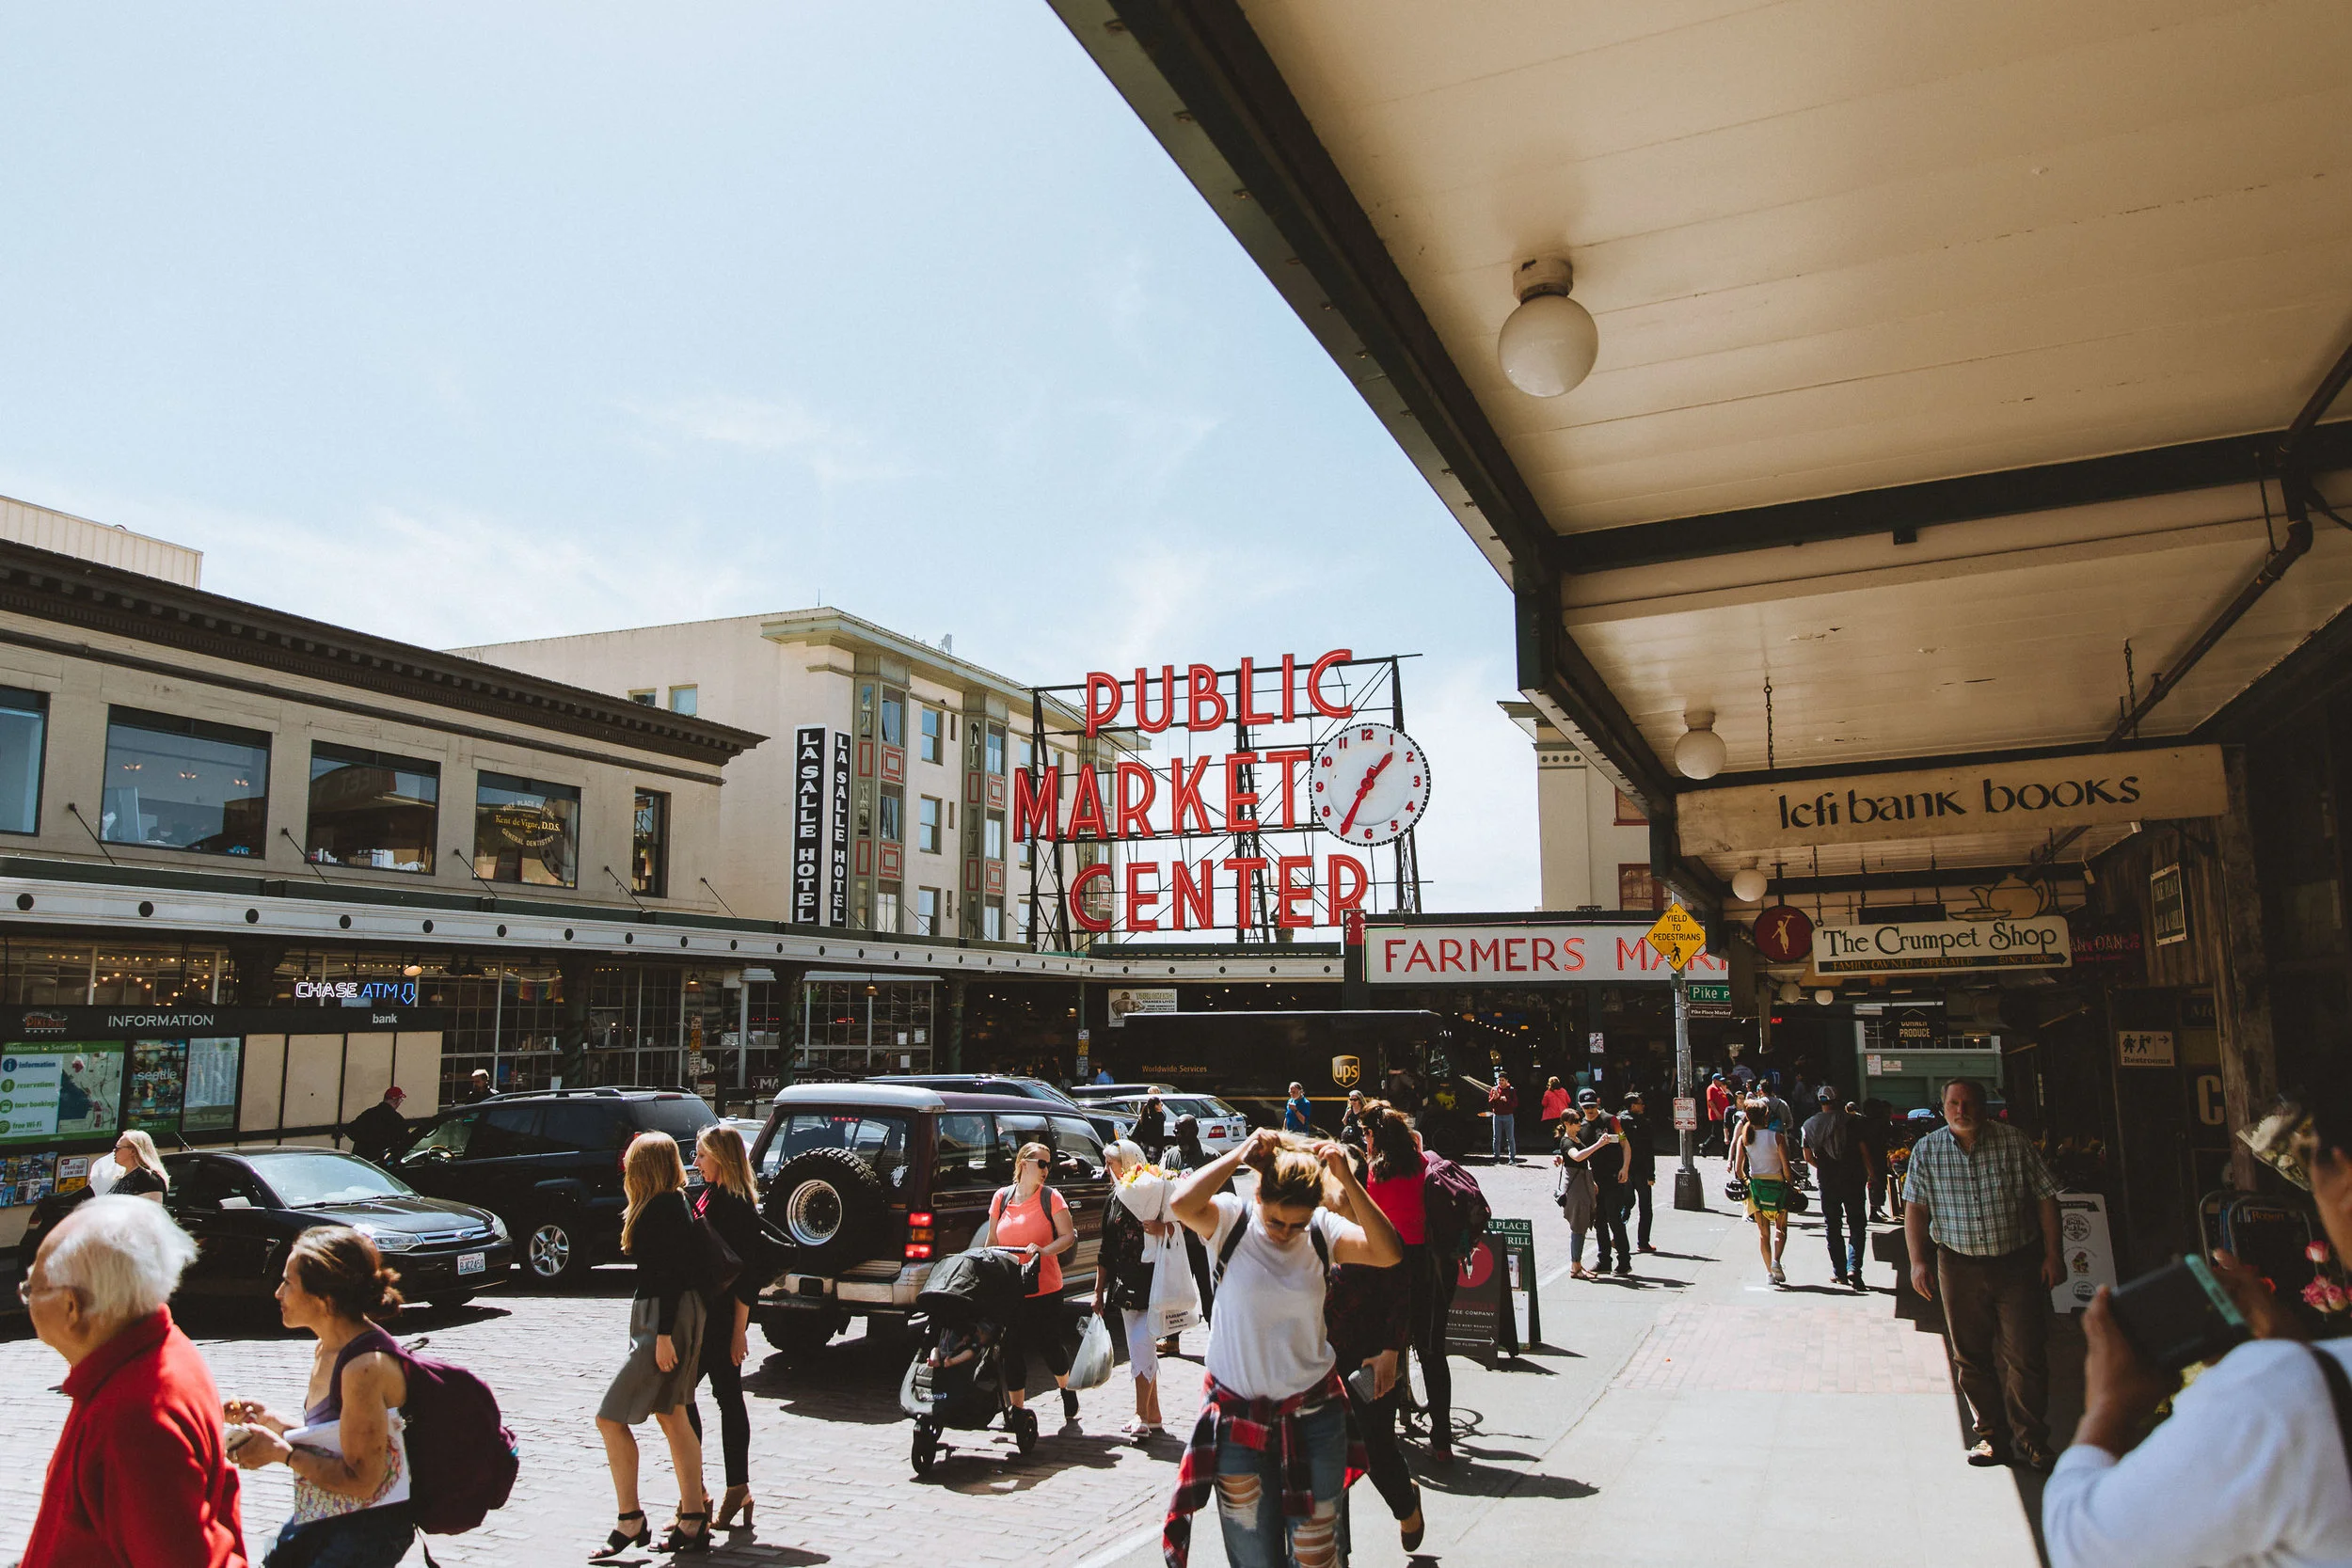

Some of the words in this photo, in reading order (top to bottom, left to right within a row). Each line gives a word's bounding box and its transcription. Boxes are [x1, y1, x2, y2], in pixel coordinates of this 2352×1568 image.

[1085, 648, 1354, 739] PUBLIC
[1360, 728, 1375, 742] 12
[1389, 734, 1394, 746] 1
[1338, 736, 1348, 750] 11
[836, 735, 848, 765] LA
[1321, 756, 1333, 768] 10
[1406, 751, 1415, 763] 2
[1315, 781, 1325, 793] 9
[1412, 775, 1422, 788] 3
[799, 766, 819, 838] SALLE
[1012, 750, 1311, 844] MARKET
[1847, 788, 1968, 825] bank
[1982, 775, 2142, 814] books
[834, 771, 848, 843] SALLE
[1322, 805, 1331, 817] 8
[1405, 800, 1416, 813] 4
[1390, 819, 1399, 832] 5
[501, 828, 524, 846] GENERAL
[526, 834, 555, 847] DENTISTRY
[1363, 828, 1374, 840] 6
[797, 848, 816, 923] HOTEL
[833, 849, 847, 923] HOTEL
[1069, 854, 1369, 932] CENTER
[1666, 914, 1688, 923] YIELD
[1823, 929, 1869, 958] The
[1874, 926, 1982, 958] Crumpet
[1988, 918, 2058, 956] Shop
[1384, 938, 1585, 973] FARMERS
[1997, 955, 2027, 965] SINCE
[295, 981, 358, 998] CHASE
[360, 983, 399, 999] ATM
[1692, 987, 1718, 999] Pike
[108, 1014, 215, 1027] INFORMATION
[372, 1013, 398, 1024] bank
[1899, 1028, 1931, 1037] PRODUCE
[2123, 1056, 2171, 1065] Restrooms
[136, 1069, 178, 1082] seattle
[1178, 1065, 1207, 1073] Services
[1334, 1065, 1359, 1083] ups
[1496, 1221, 1530, 1230] PLACE
[1506, 1237, 1531, 1245] RILL
